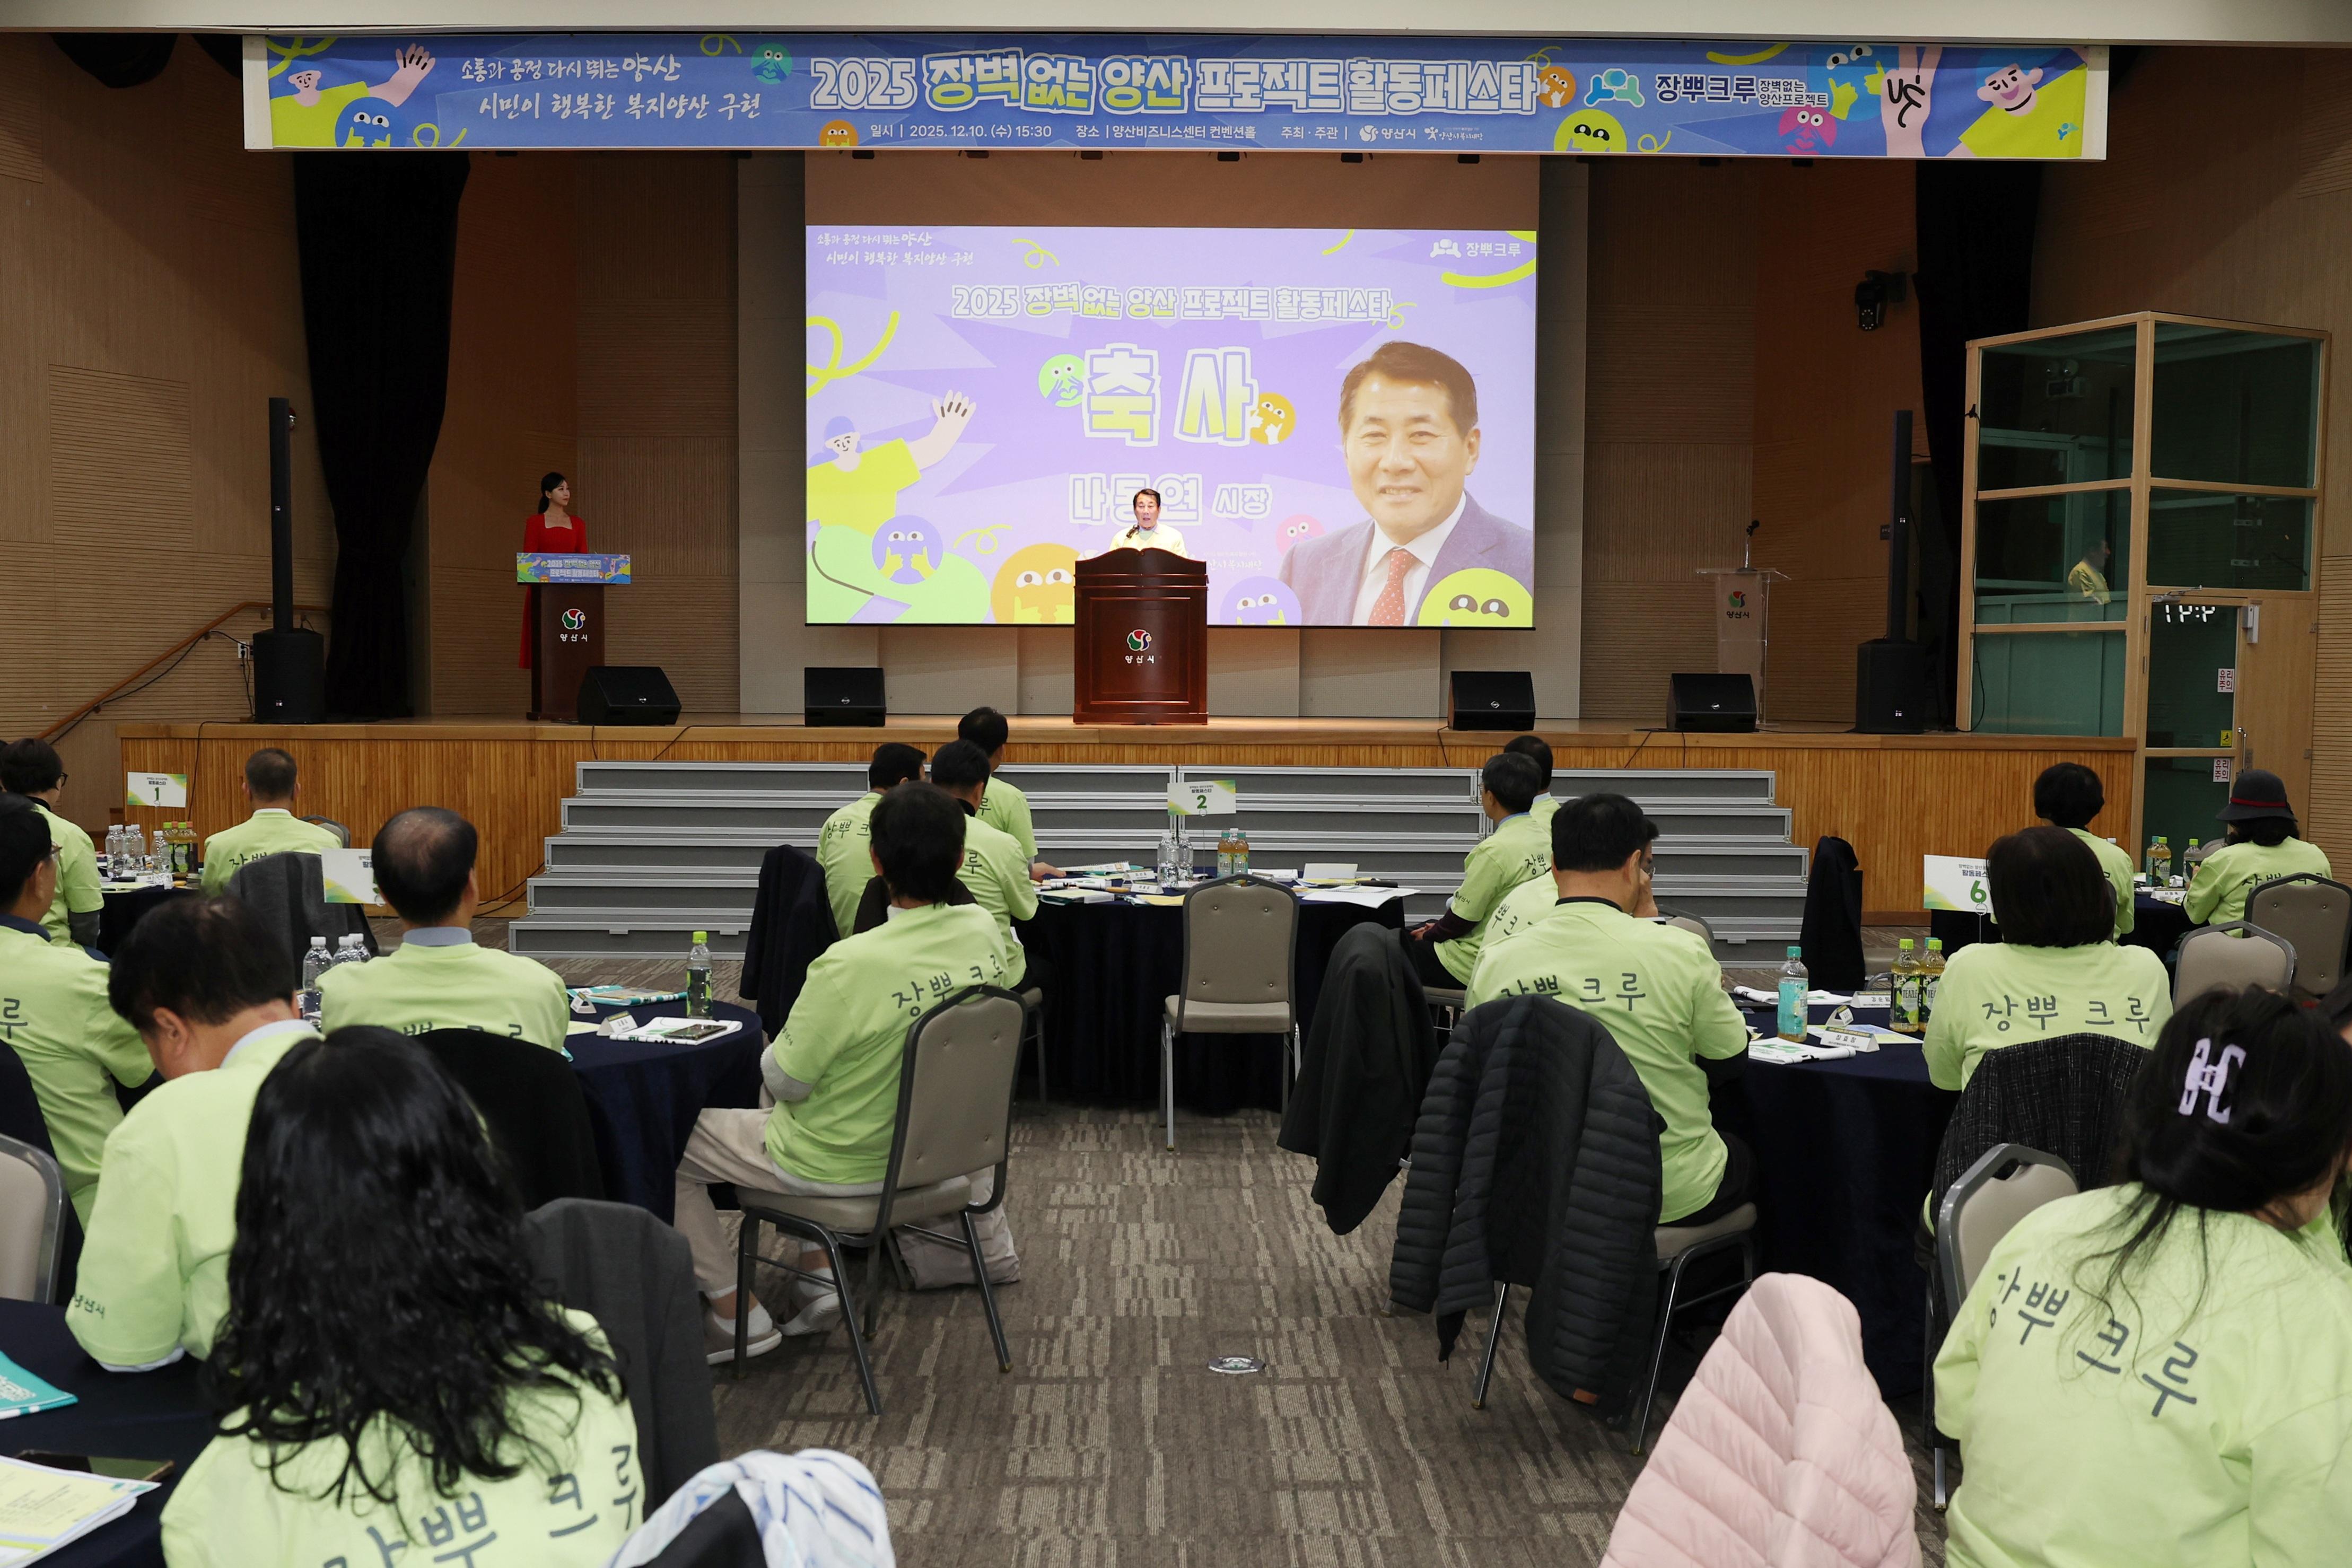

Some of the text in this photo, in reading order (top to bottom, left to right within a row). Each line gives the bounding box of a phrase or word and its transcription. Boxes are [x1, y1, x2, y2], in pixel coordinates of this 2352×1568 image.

[461, 52, 681, 82] 소통과 공정 다시 뛰는 양산
[810, 54, 917, 111] 2025
[1098, 53, 1190, 114] 양산
[1195, 57, 1343, 113] 프로젝트
[1345, 57, 1538, 116] 활동페스타
[1656, 74, 1759, 103] 장뿌크루
[1760, 80, 1805, 93] 장벽없는
[479, 92, 760, 120] 시민이 행복한 복지양산 구현
[1760, 93, 1828, 106] 양산프로젝트
[871, 125, 1052, 138] 일시 2025. 12.10. (수) 15:30
[1076, 125, 1256, 139] 장소 양산비즈니스센터 컨벤션홀
[1281, 126, 1338, 139] 주최 주관
[1381, 128, 1416, 139] 양산시
[817, 233, 841, 246] 소통과
[863, 234, 880, 244] 다시
[902, 232, 932, 247] 양산
[1466, 242, 1520, 257] 장뿌크루
[826, 251, 859, 264] 시민이
[864, 251, 898, 265] 행복한
[951, 252, 974, 266] 구현
[952, 285, 1019, 318] 2025
[1126, 286, 1177, 320] 양산
[1181, 286, 1272, 320] 프로젝트
[1273, 286, 1393, 323] 활동페스타
[1211, 483, 1272, 520] 시장
[560, 634, 588, 642] 양산시
[1125, 655, 1155, 664] 양산시
[2219, 670, 2233, 679] 유리
[2219, 680, 2233, 690] 주의
[2215, 760, 2229, 769] 유리
[2215, 770, 2228, 780] 주의
[154, 787, 159, 801] 1
[1196, 795, 1207, 809] 2
[1970, 880, 1987, 904] 6
[1579, 973, 1646, 1011] 크루
[1903, 989, 1918, 998] TEAZLE
[2085, 997, 2150, 1033] 크루
[2077, 1319, 2197, 1418] 크루
